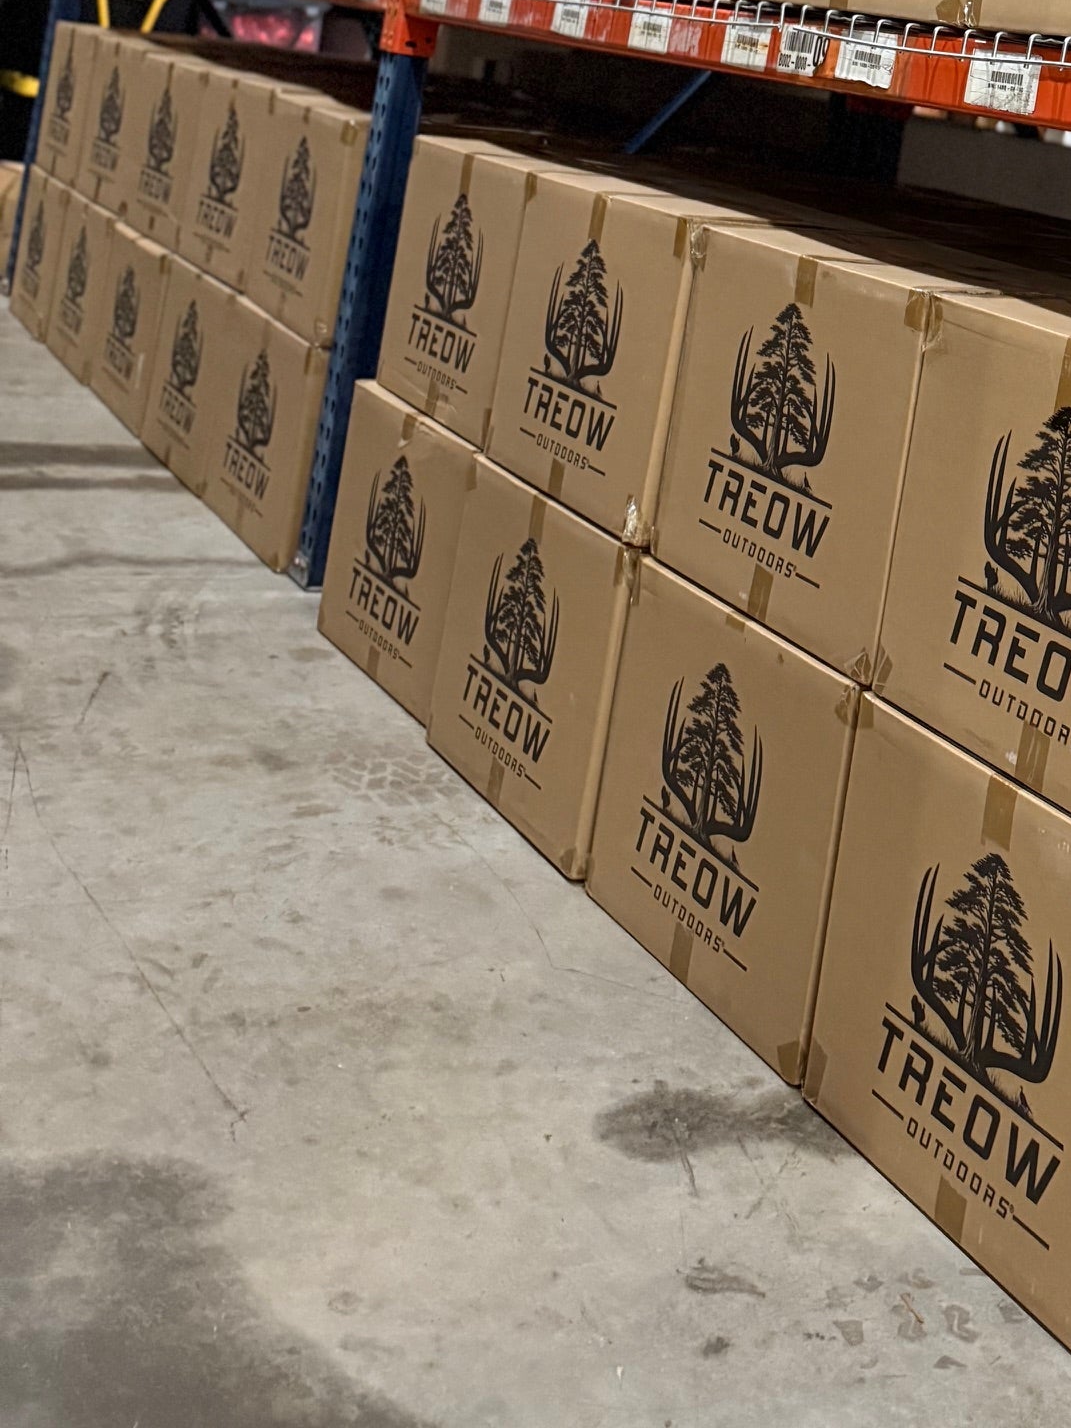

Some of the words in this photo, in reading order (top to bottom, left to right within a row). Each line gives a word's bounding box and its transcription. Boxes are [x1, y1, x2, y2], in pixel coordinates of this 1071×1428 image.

[408, 312, 476, 373] TREOW
[523, 377, 615, 451] TREOW
[536, 432, 588, 471] OUTDOORS
[704, 459, 830, 558] TREOW
[722, 528, 794, 578] OUTDOORS
[349, 567, 419, 646] TREOW
[462, 664, 551, 764] TREOW
[474, 726, 524, 777] OUTDOORS
[635, 806, 757, 938] TREOW
[653, 884, 722, 953] OUTDOORS
[877, 1016, 1061, 1205] TREOW
[906, 1117, 1010, 1219] OUTDOORS
